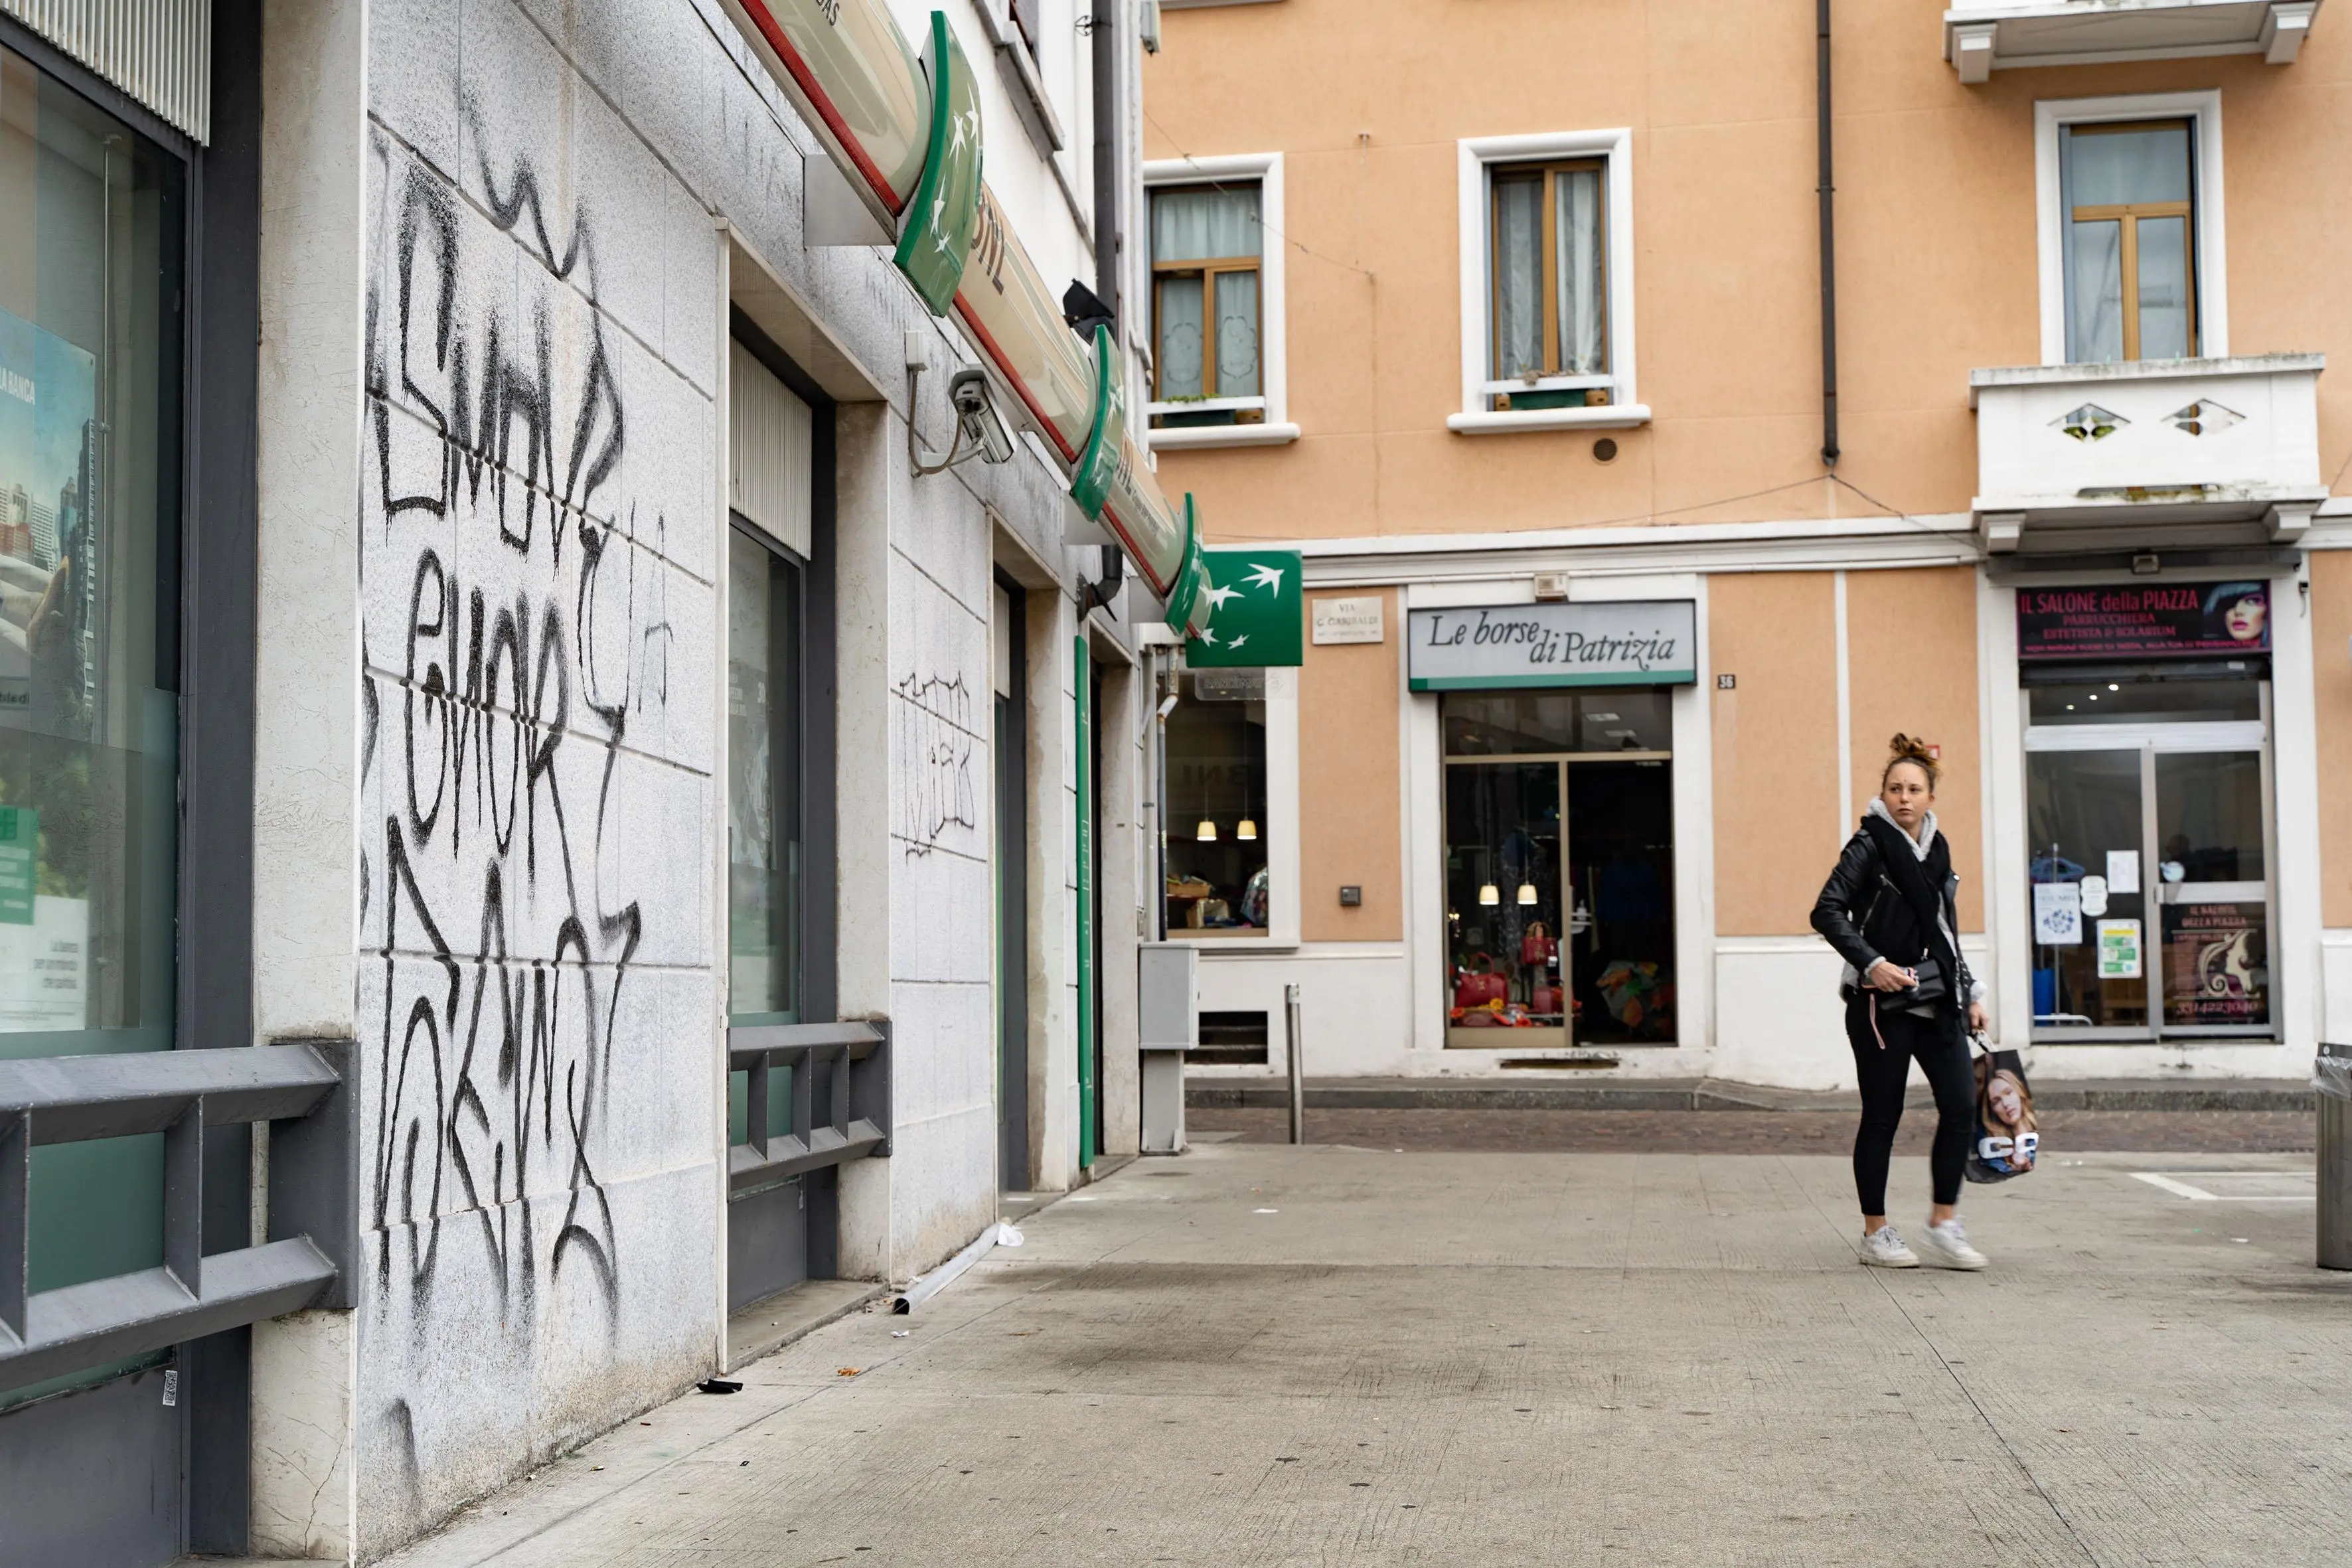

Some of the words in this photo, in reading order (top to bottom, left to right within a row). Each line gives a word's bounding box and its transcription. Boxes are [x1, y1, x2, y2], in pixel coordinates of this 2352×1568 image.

[816, 0, 840, 26] AS
[8, 370, 36, 406] BANCA
[1338, 603, 1356, 613] VIA
[2021, 595, 2033, 614] IL
[2037, 592, 2097, 613] SALONE
[2102, 591, 2140, 611] della
[2144, 589, 2199, 610] PIAZZA
[1427, 615, 1467, 646] Le
[1473, 611, 1540, 645] borse
[1529, 629, 1561, 664] di
[1561, 629, 1676, 672] Patrizia
[1719, 675, 1734, 688] 36
